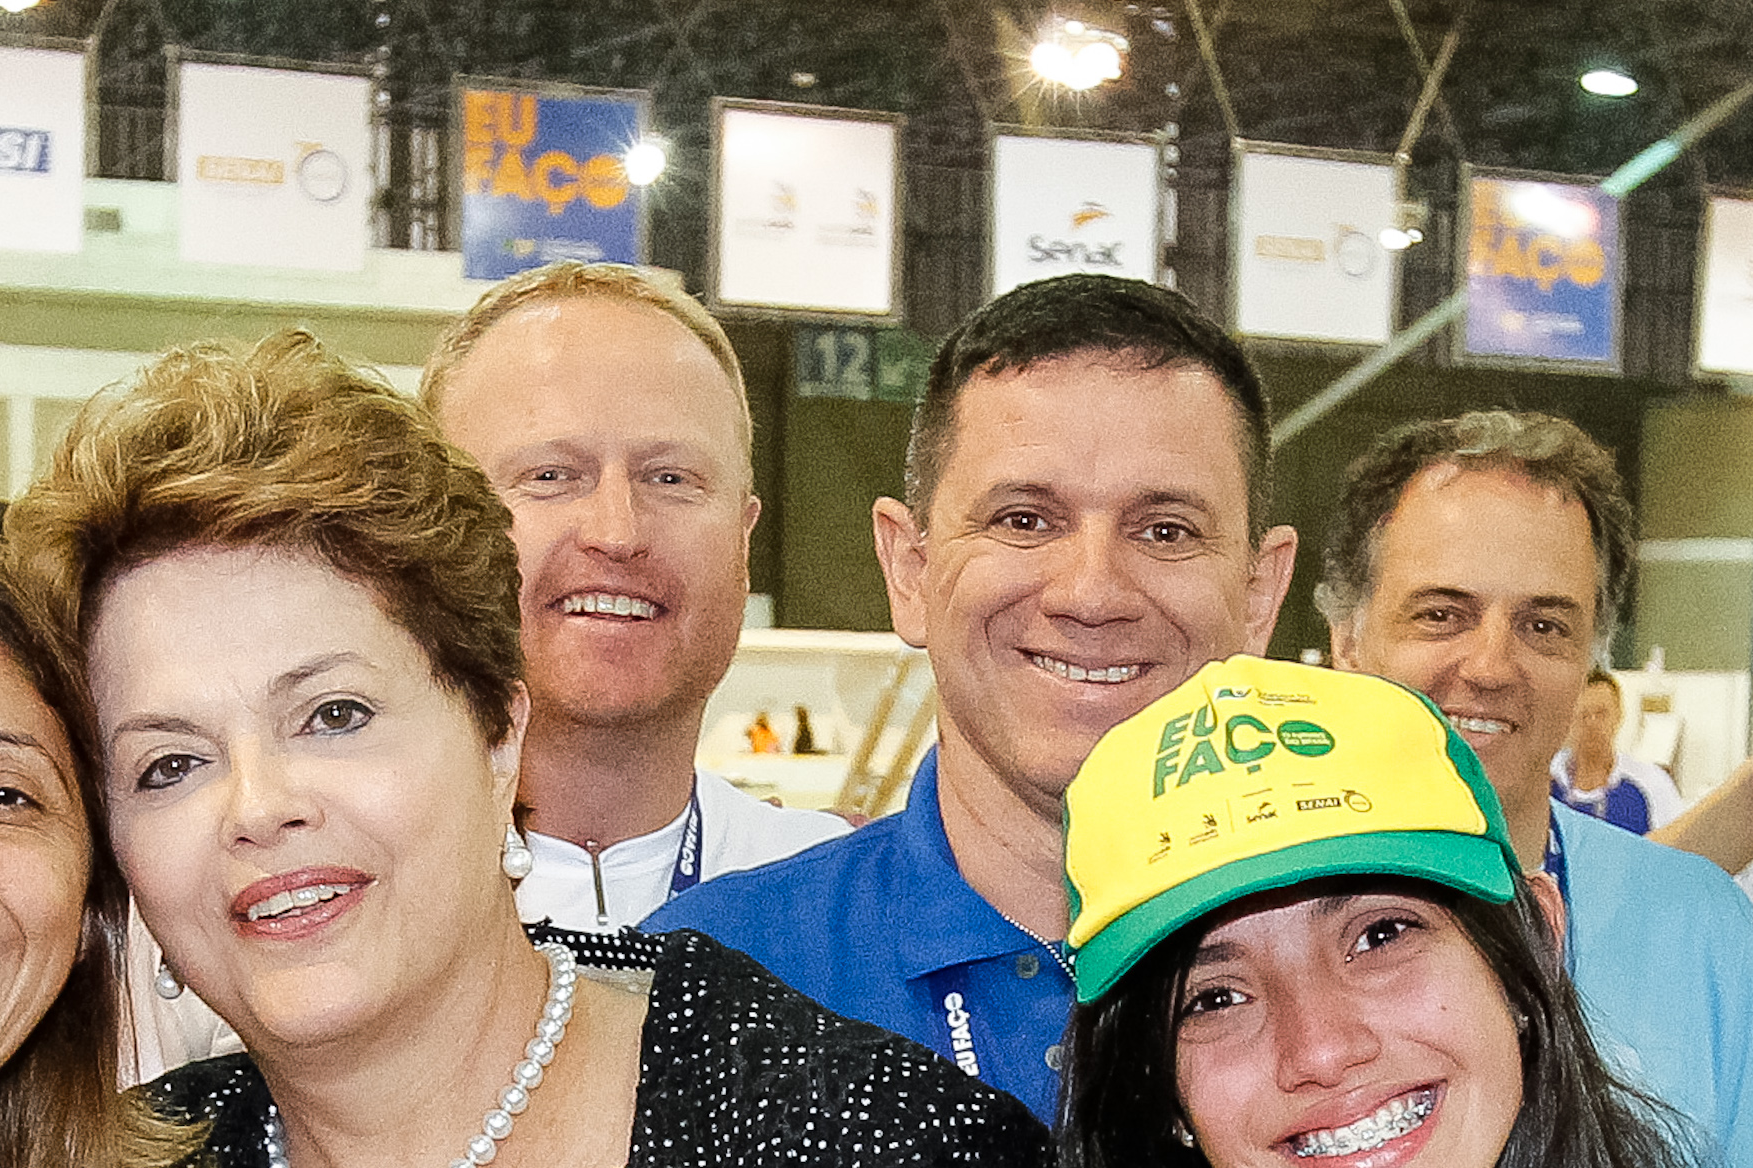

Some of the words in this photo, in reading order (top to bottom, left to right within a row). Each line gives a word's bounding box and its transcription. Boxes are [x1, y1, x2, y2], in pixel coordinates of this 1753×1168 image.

[464, 90, 538, 146] EU
[815, 332, 871, 390] 12
[1298, 797, 1341, 811] SENAI
